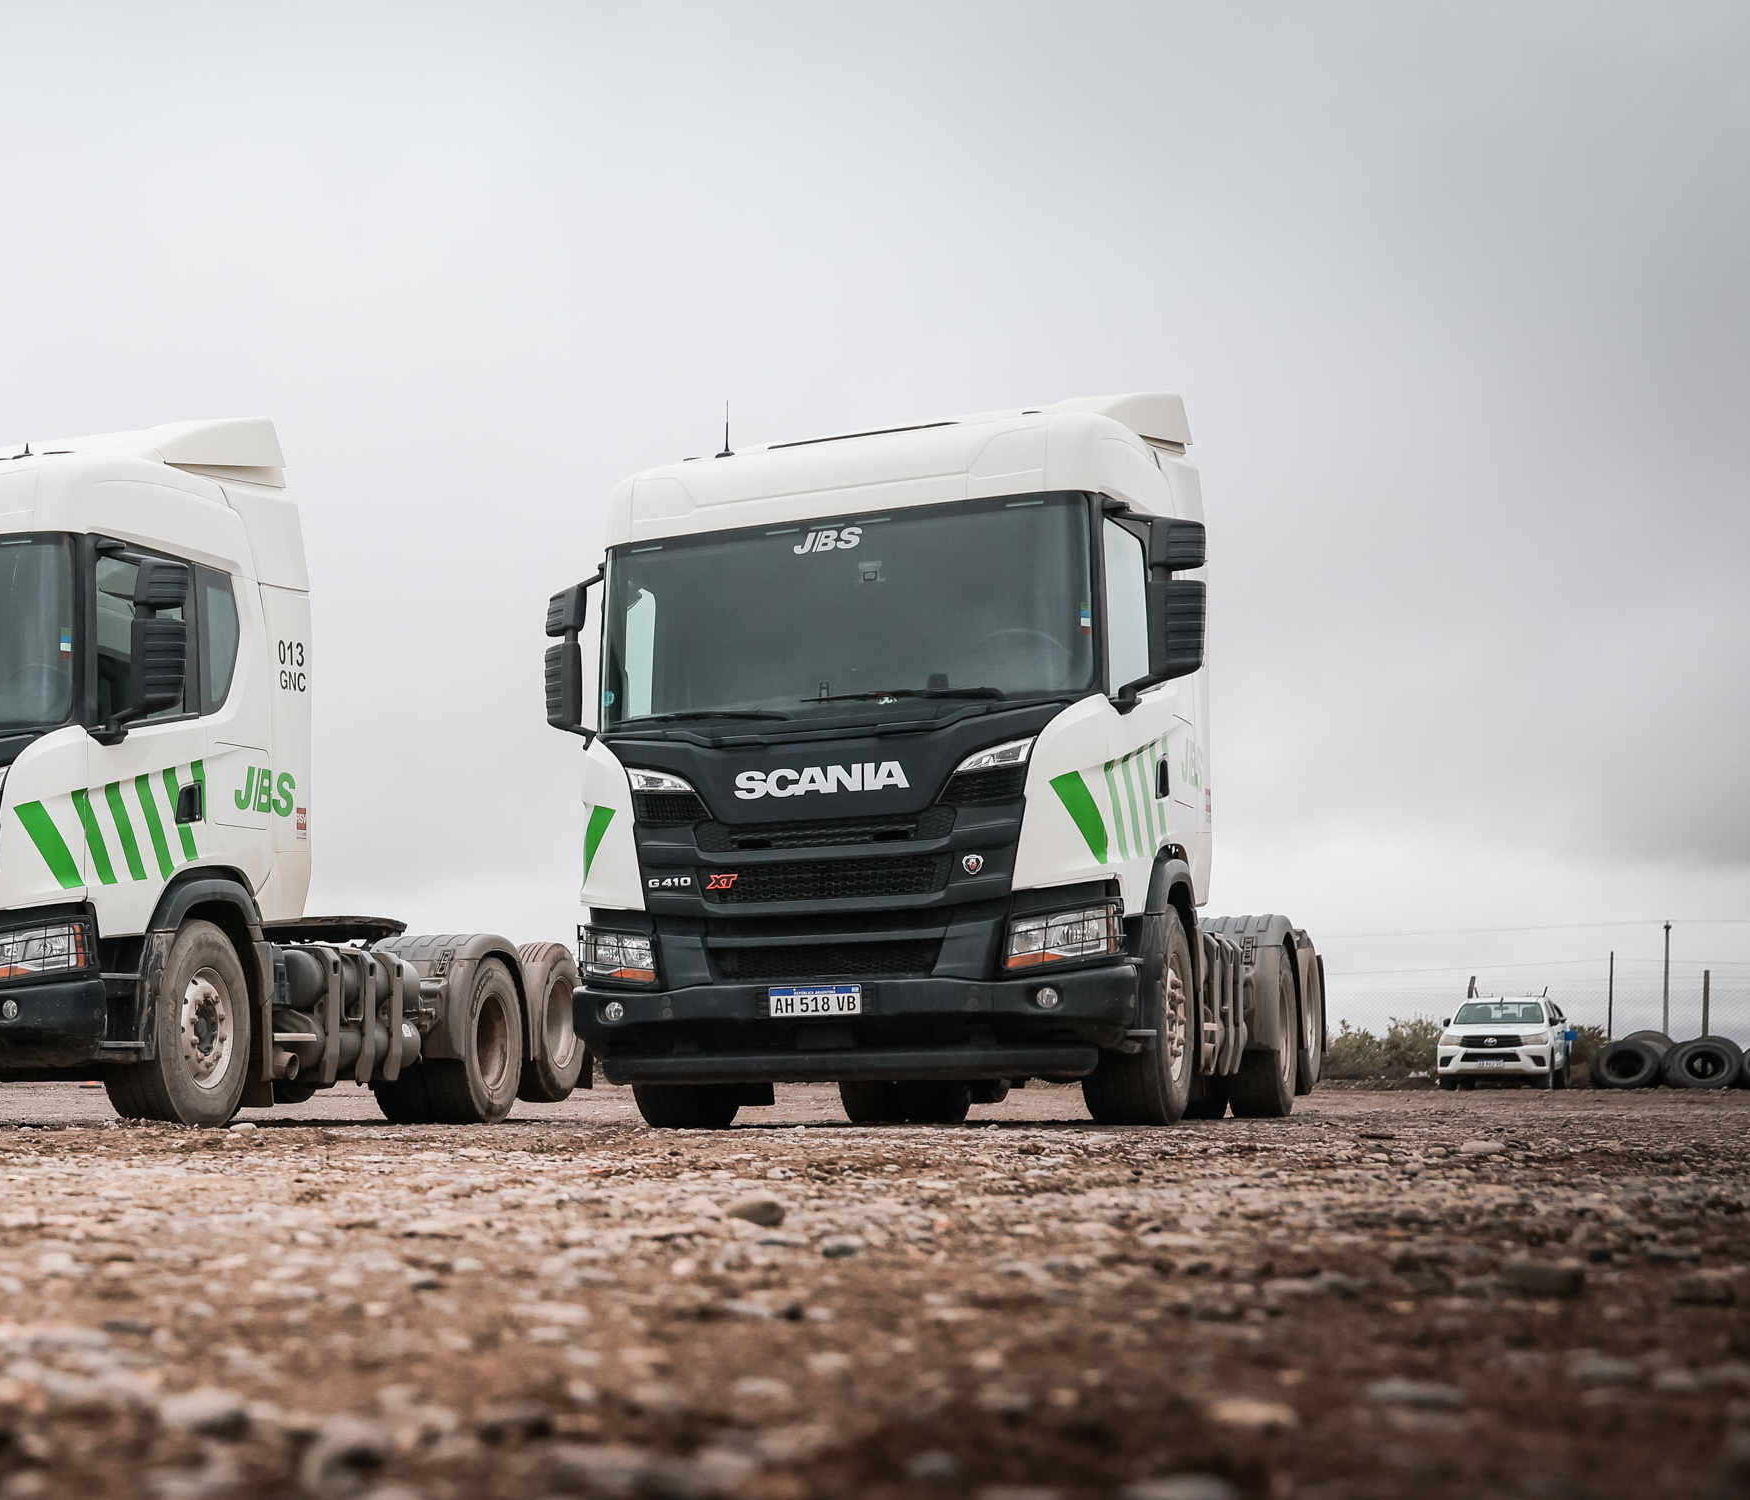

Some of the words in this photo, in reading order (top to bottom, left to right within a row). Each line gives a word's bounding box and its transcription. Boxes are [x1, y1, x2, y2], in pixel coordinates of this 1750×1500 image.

[793, 525, 863, 555] JBS
[278, 639, 305, 668] 013
[279, 669, 307, 693] GNC
[234, 765, 296, 818] JBS
[733, 760, 911, 801] SCANIA
[705, 873, 739, 890] XT
[774, 997, 794, 1014] AH
[799, 996, 831, 1013] 518
[836, 995, 857, 1012] VB
